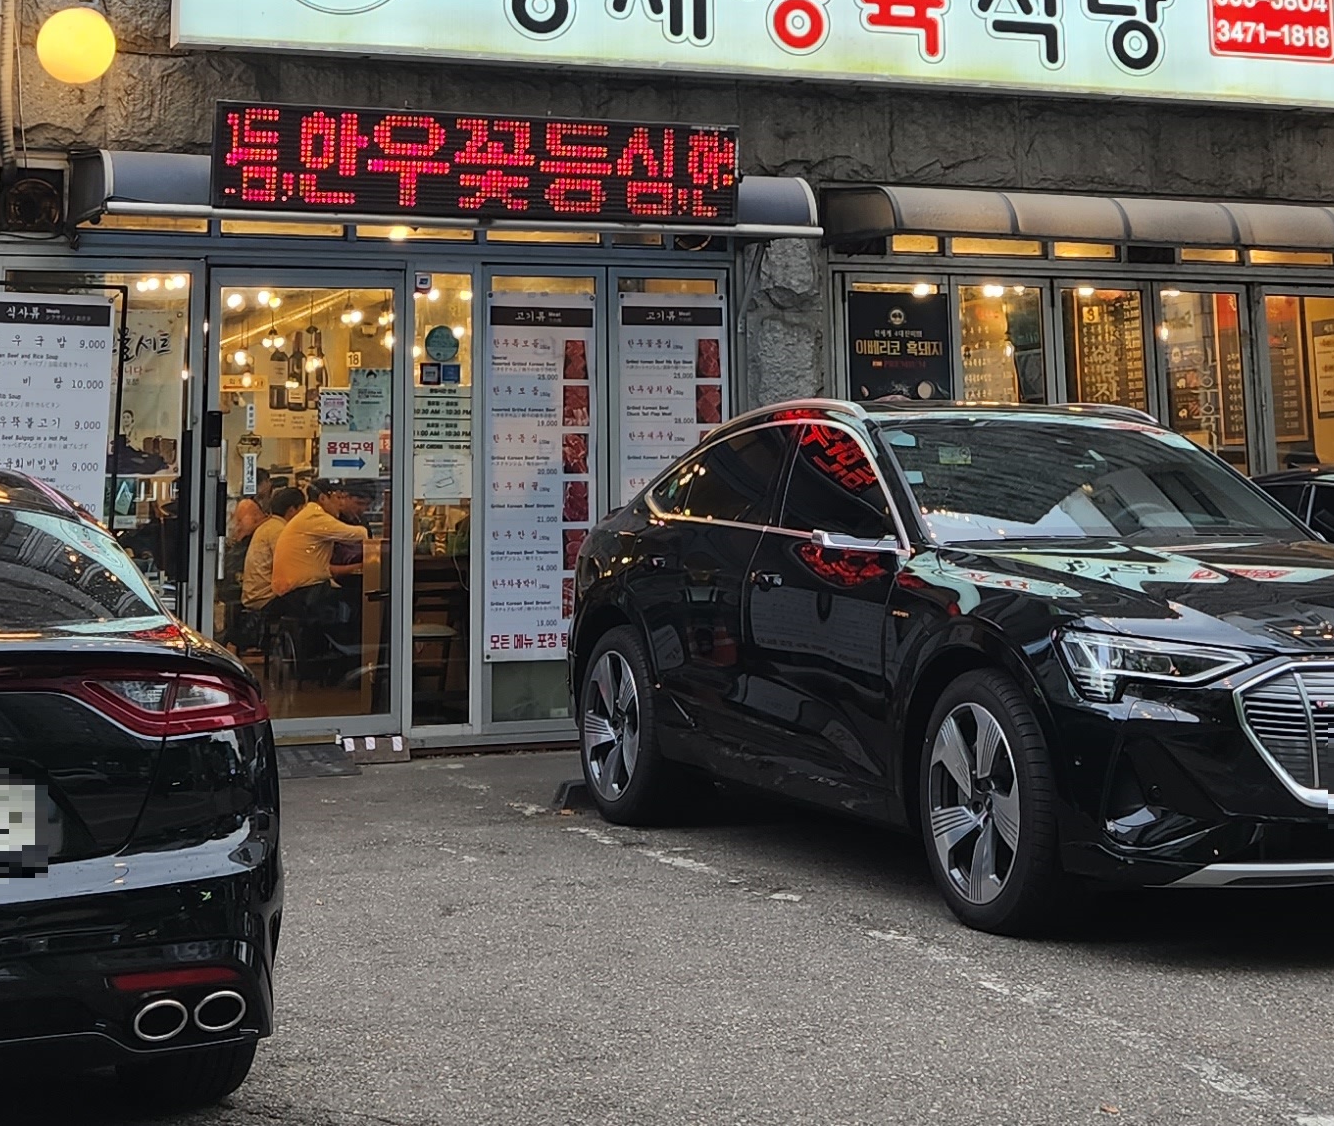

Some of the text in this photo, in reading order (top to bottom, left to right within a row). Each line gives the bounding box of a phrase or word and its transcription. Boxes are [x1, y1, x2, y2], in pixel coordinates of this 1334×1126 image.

[1215, 19, 1330, 50] 3471-1818
[5, 305, 41, 320] 식사류
[515, 310, 545, 322] 고기류
[646, 310, 676, 322] 고기류
[855, 339, 943, 356] 이베리코 흑돼지
[348, 354, 359, 366] 18
[327, 441, 374, 456] 흡연구역
[490, 632, 558, 650] 모든 메뉴 포장
